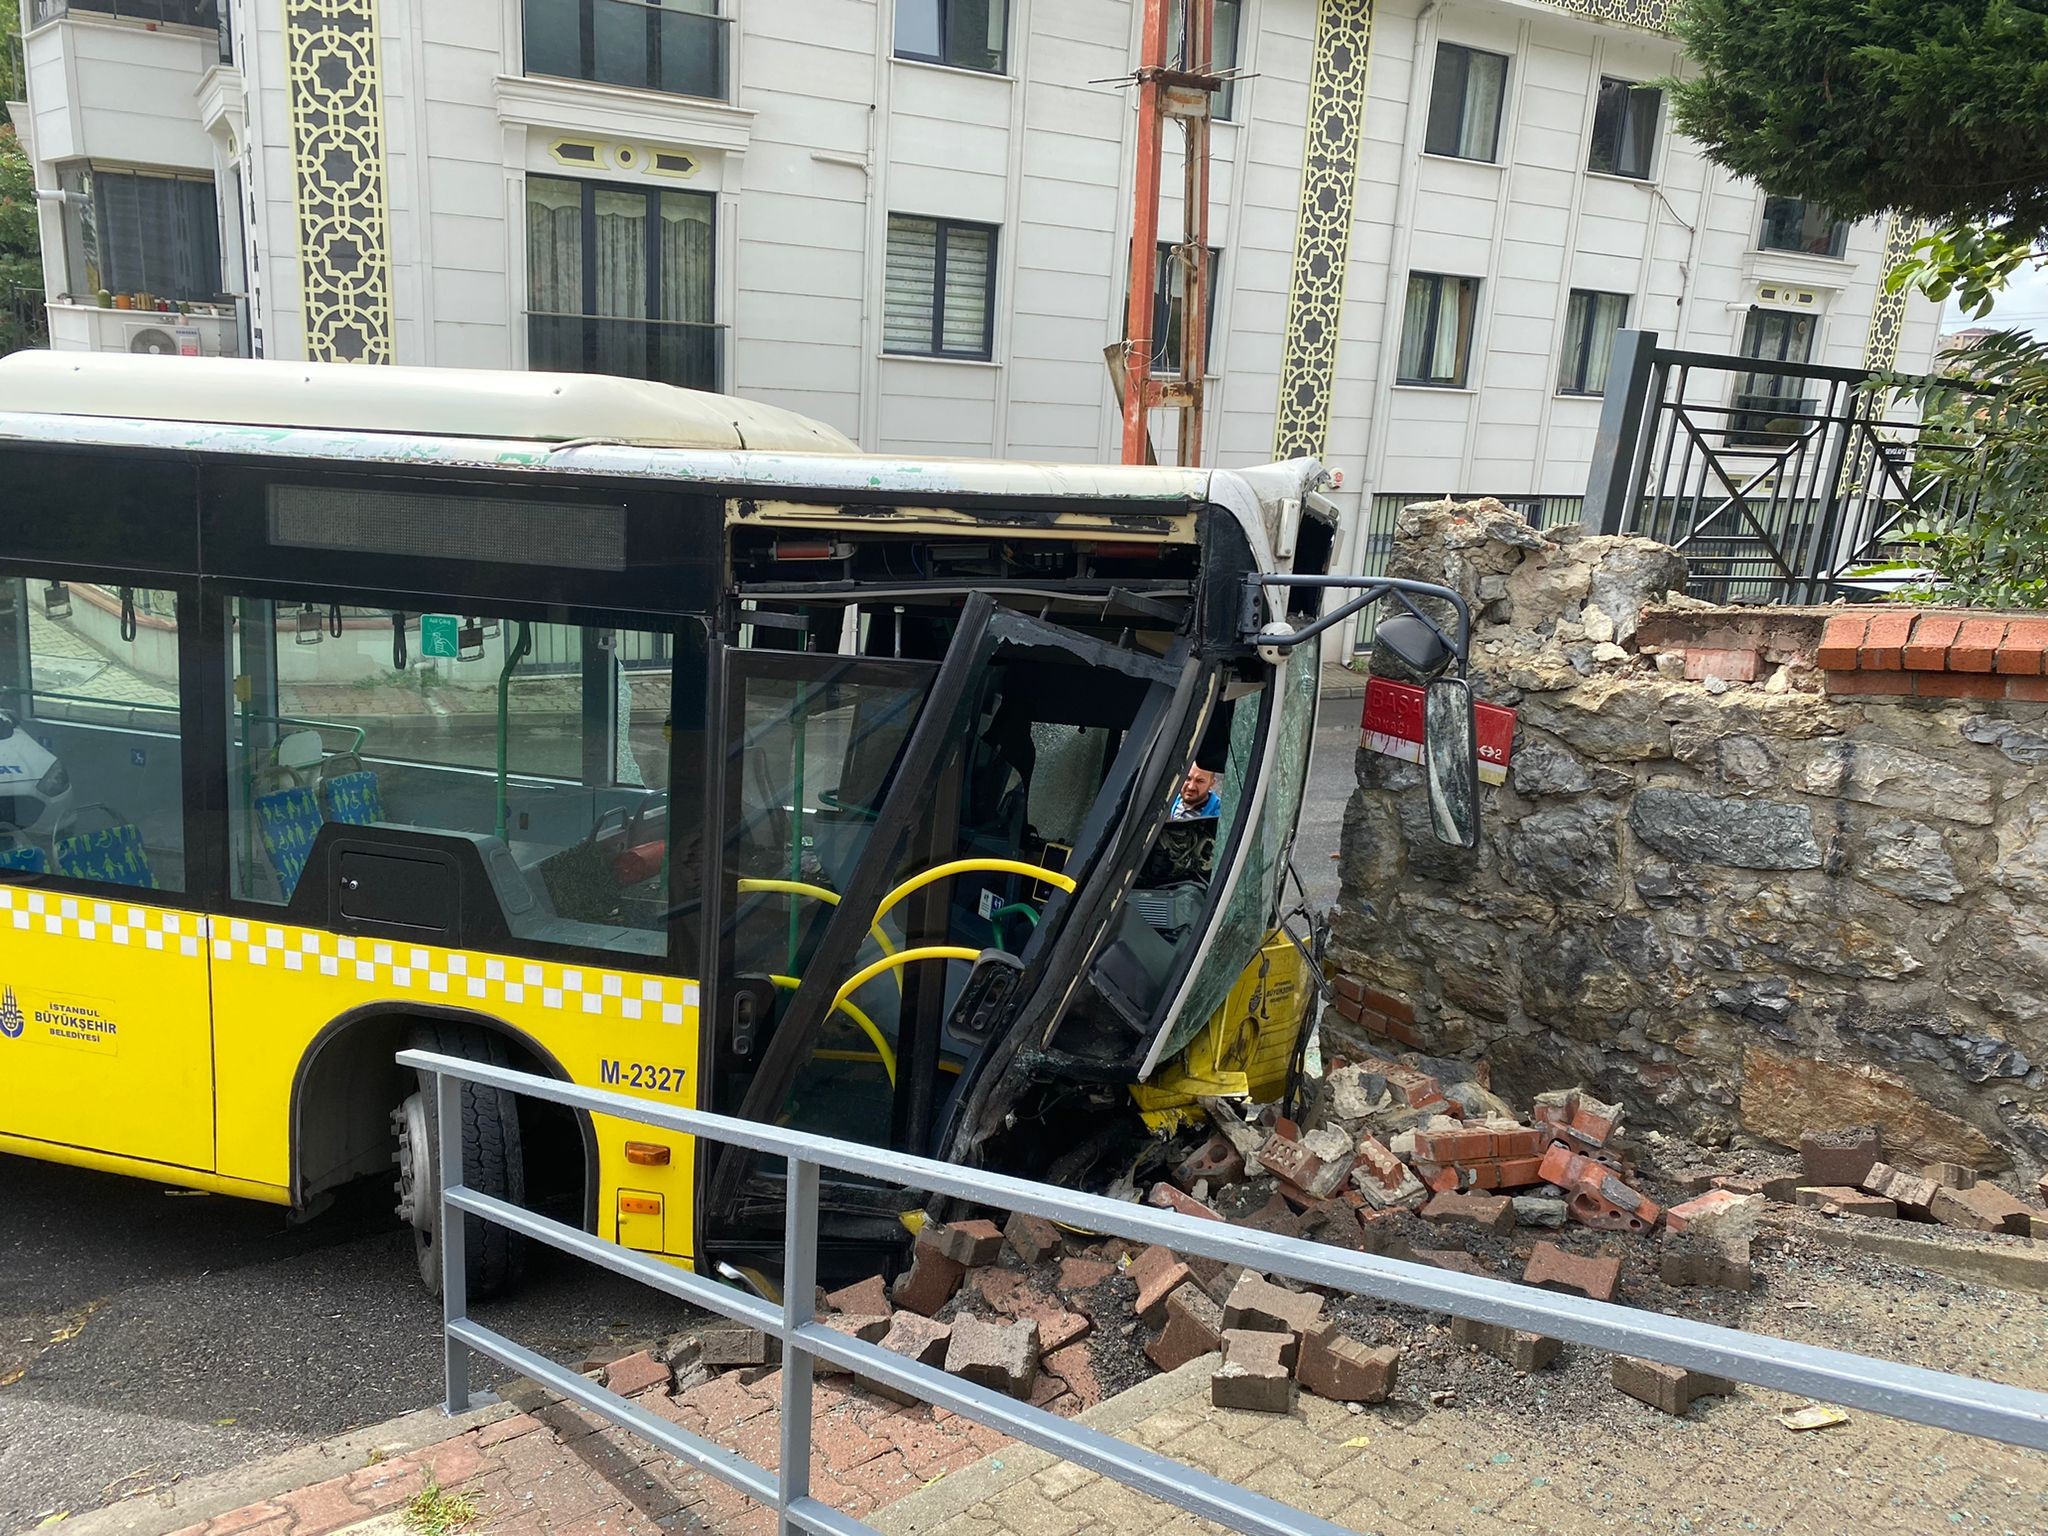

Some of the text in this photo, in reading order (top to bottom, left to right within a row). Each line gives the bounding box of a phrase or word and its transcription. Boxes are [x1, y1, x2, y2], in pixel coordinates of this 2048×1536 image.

[1372, 688, 1423, 718] BAŞA
[1494, 748, 1502, 760] 2
[34, 1011, 117, 1034] BÜYÜKŞEHİR
[49, 1028, 101, 1043] BELEDİYESİ
[601, 1059, 686, 1093] M-2327
